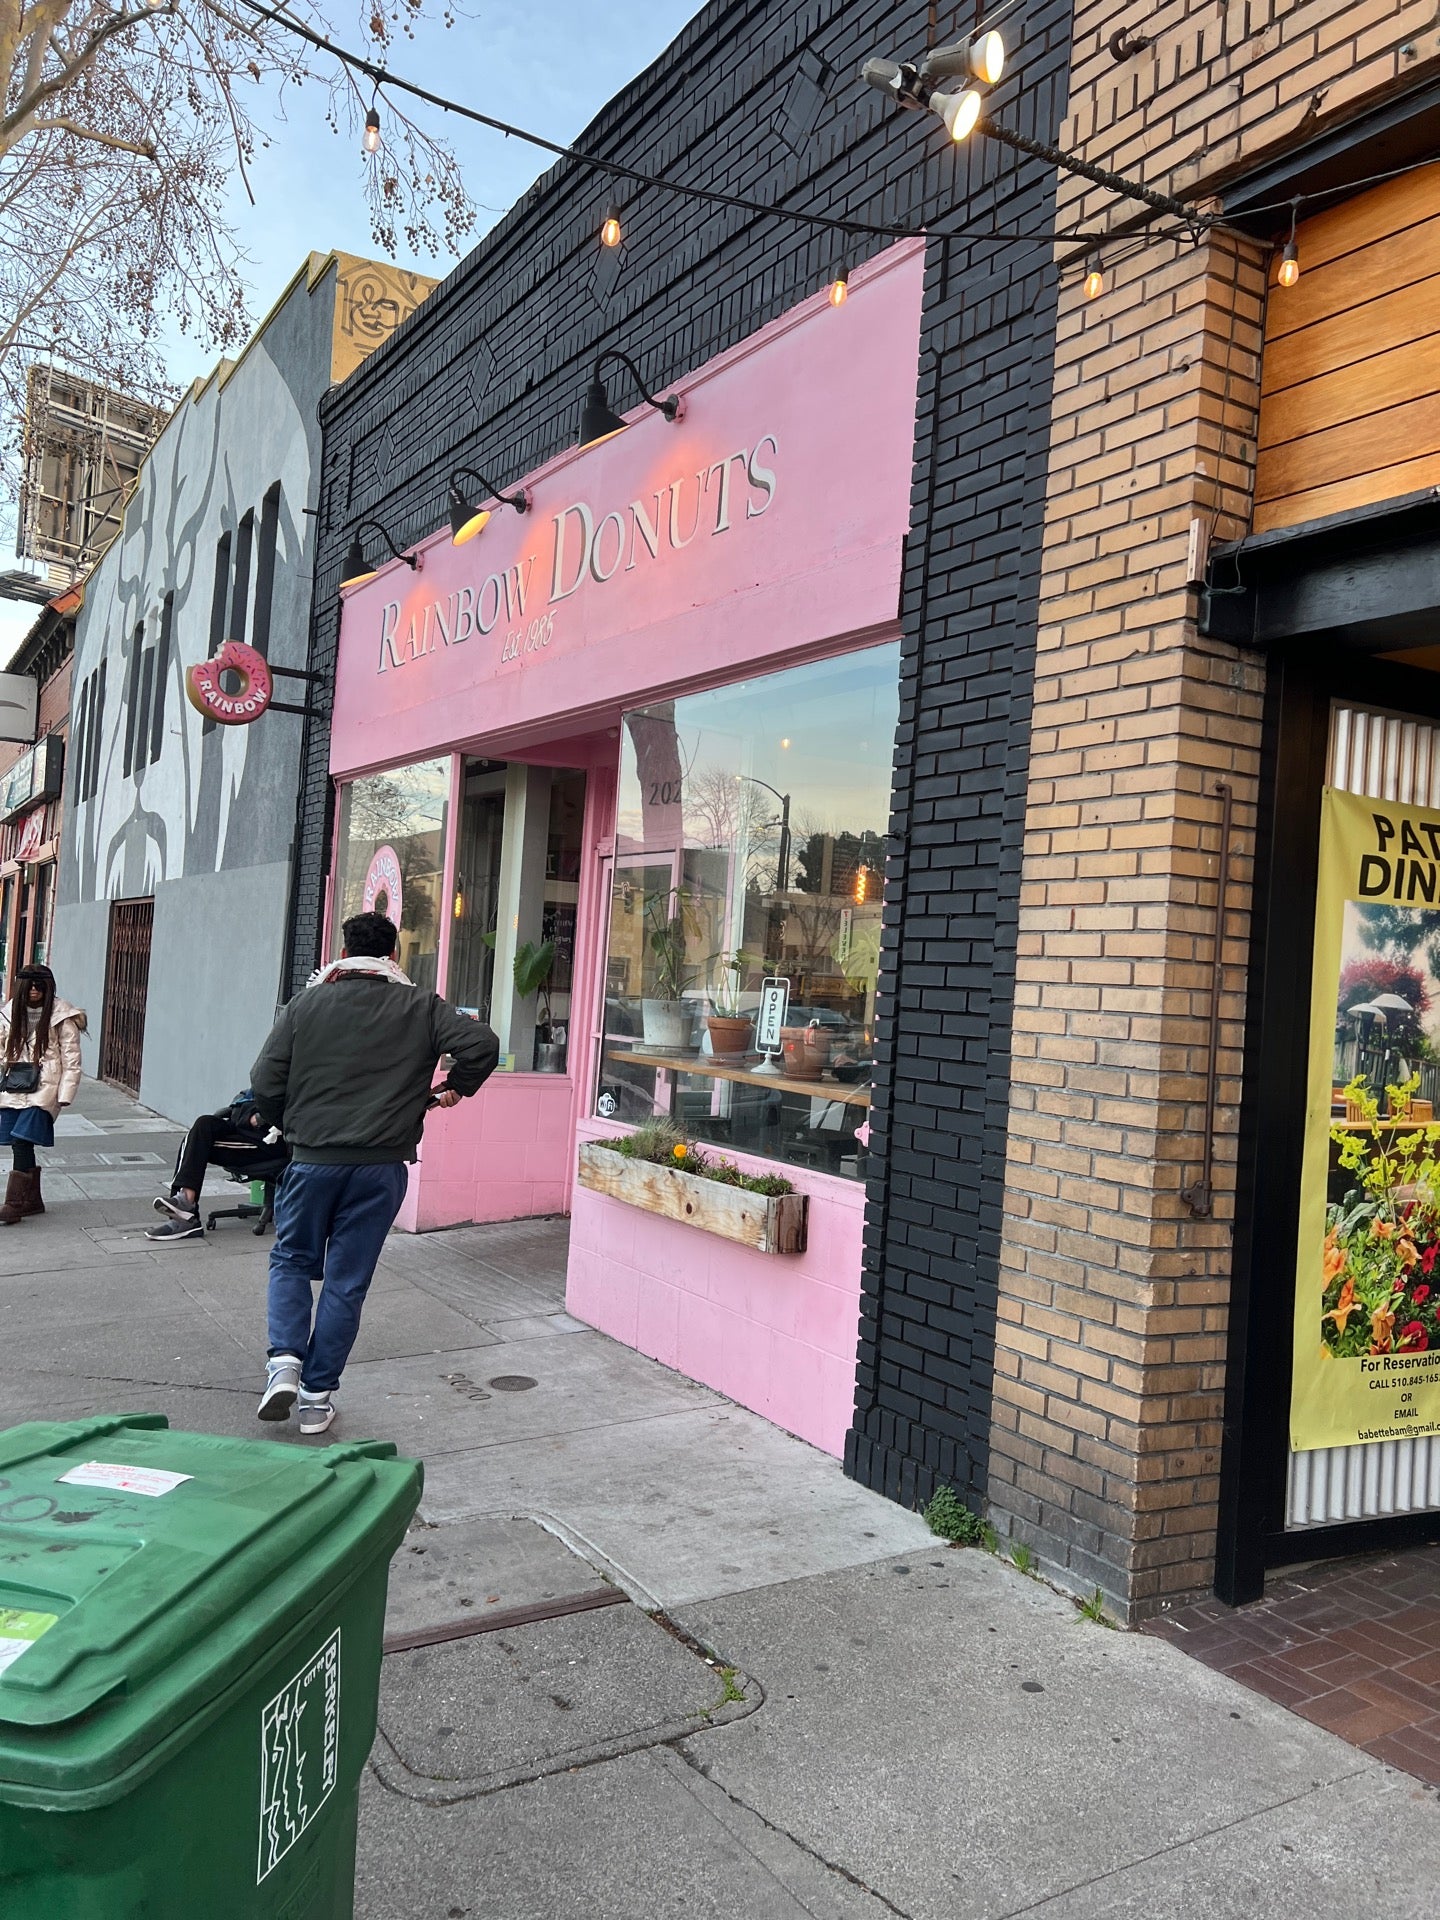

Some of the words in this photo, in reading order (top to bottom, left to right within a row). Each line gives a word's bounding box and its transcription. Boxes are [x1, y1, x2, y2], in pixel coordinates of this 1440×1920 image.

[377, 555, 537, 675] RAINBOW
[547, 433, 779, 606] DONUTS
[523, 609, 558, 653] 1985
[200, 680, 267, 714] RAINBOW
[1372, 813, 1440, 861] PAT
[366, 857, 399, 904] RAINBOW
[1358, 854, 1440, 903] DIN
[767, 991, 778, 1040] OPEN
[1361, 1359, 1381, 1372] For
[1383, 1353, 1440, 1370] Reservatio
[1369, 1379, 1390, 1389] CALL
[1392, 1373, 1440, 1388] 510.845-165
[1394, 1408, 1419, 1419] EMAIL
[1400, 1393, 1413, 1402] OR
[1358, 1421, 1440, 1440] babettebam@gmail.c
[323, 1642, 337, 1791] BERKELEY
